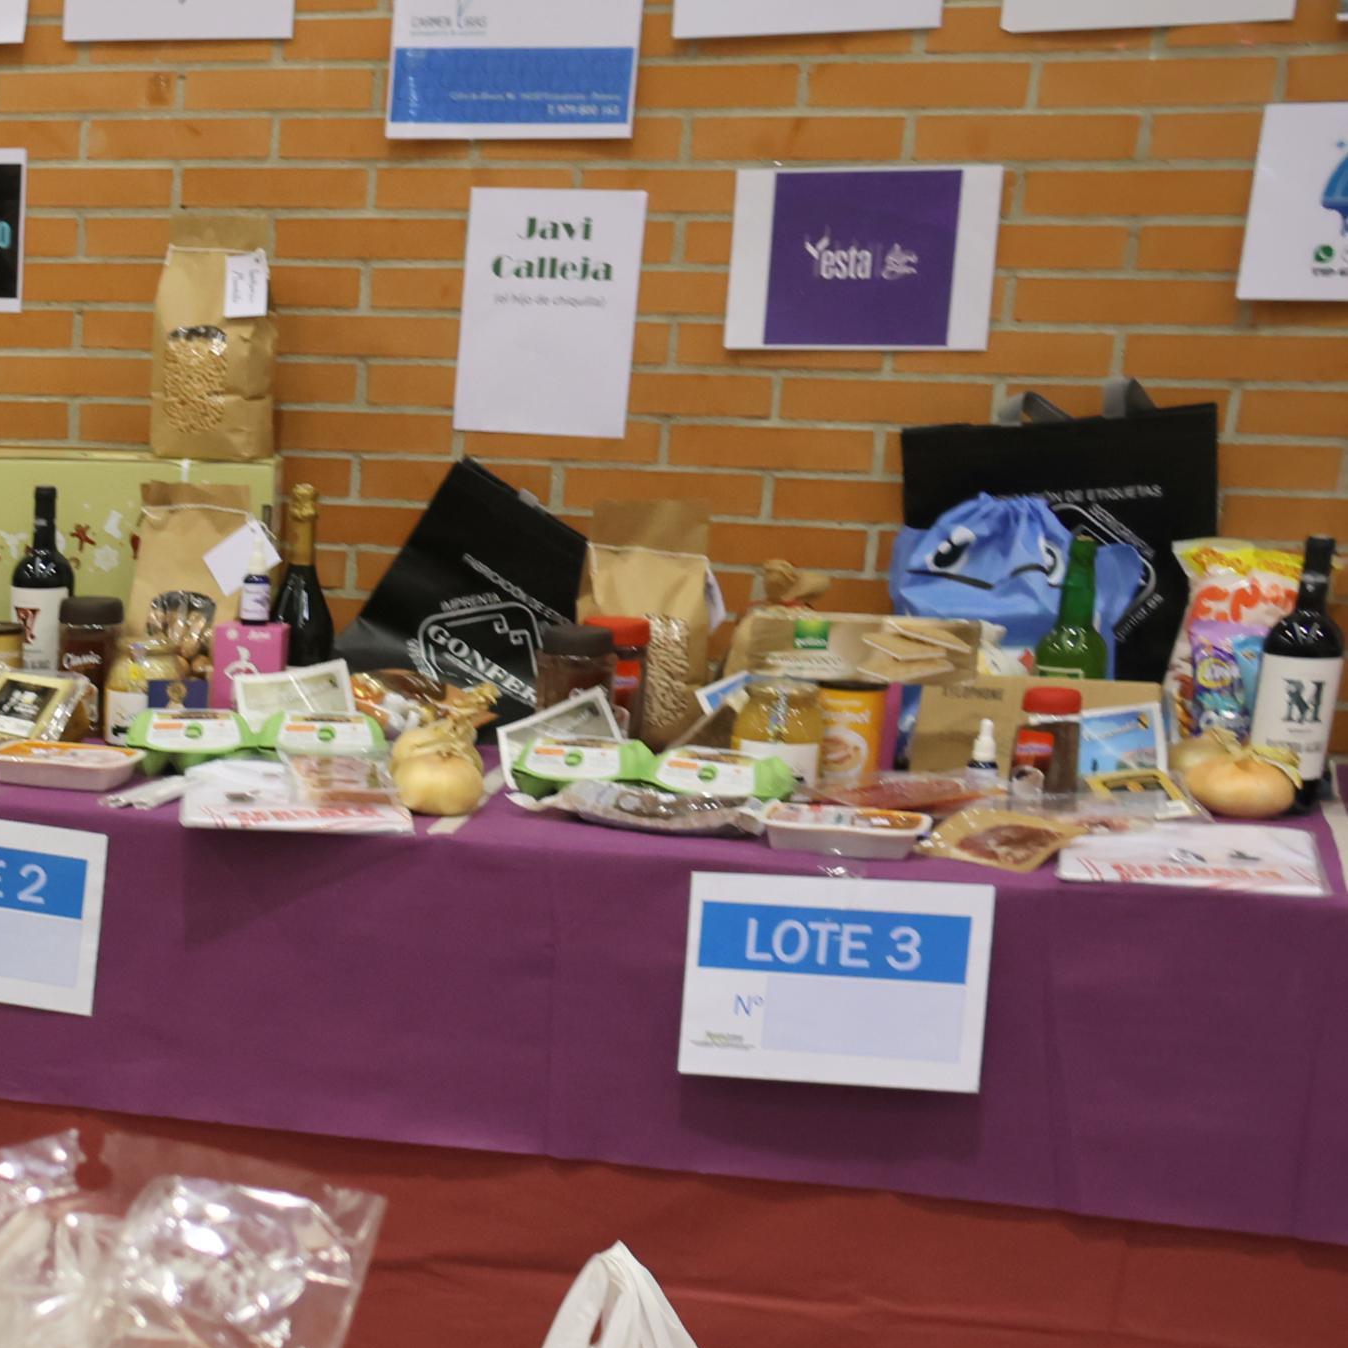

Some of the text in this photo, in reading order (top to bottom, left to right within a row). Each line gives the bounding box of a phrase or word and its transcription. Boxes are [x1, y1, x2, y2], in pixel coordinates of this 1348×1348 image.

[517, 216, 593, 241] Javi
[491, 255, 614, 281] Calleja
[17, 863, 49, 906] 2
[743, 917, 923, 973] LOTE 3
